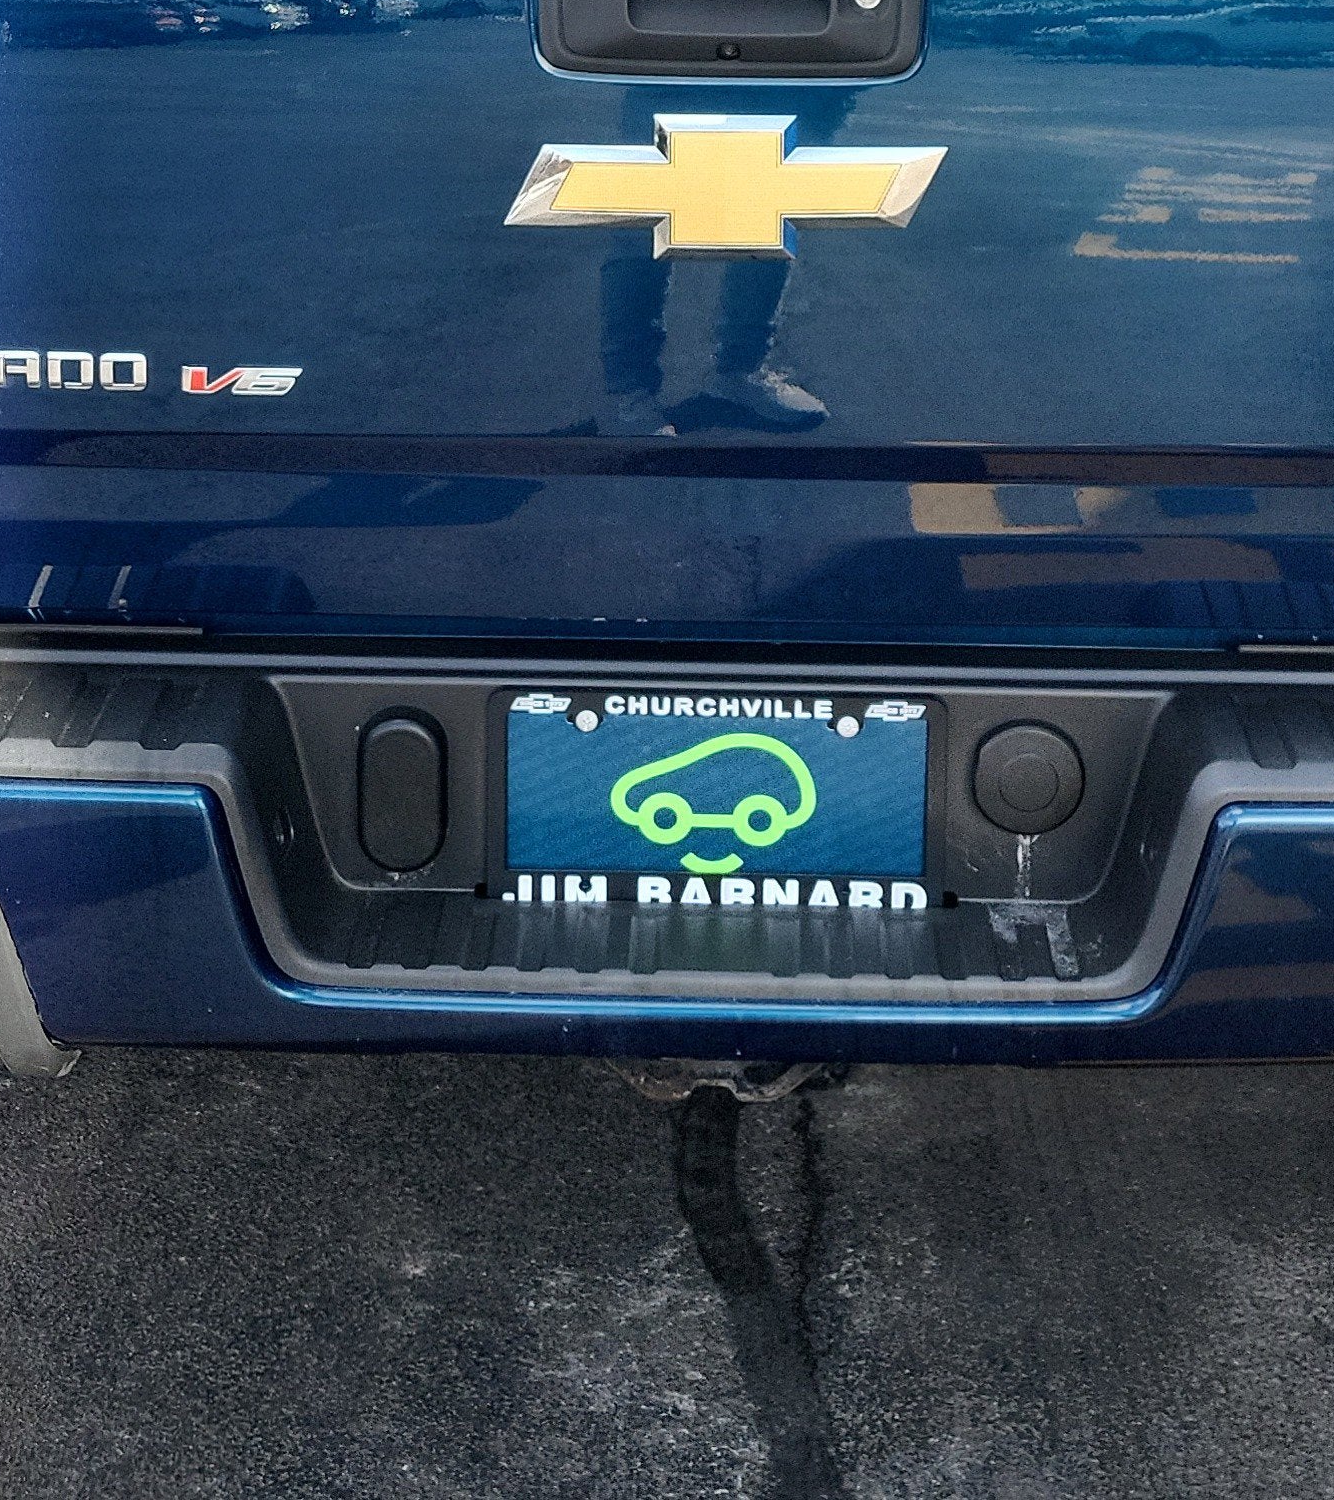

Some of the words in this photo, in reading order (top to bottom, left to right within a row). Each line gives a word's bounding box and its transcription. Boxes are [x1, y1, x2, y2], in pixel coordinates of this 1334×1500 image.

[180, 364, 304, 397] V6
[604, 695, 834, 721] CHURCHVILLE
[501, 873, 608, 904] JIM
[636, 876, 929, 911] BARNARD
